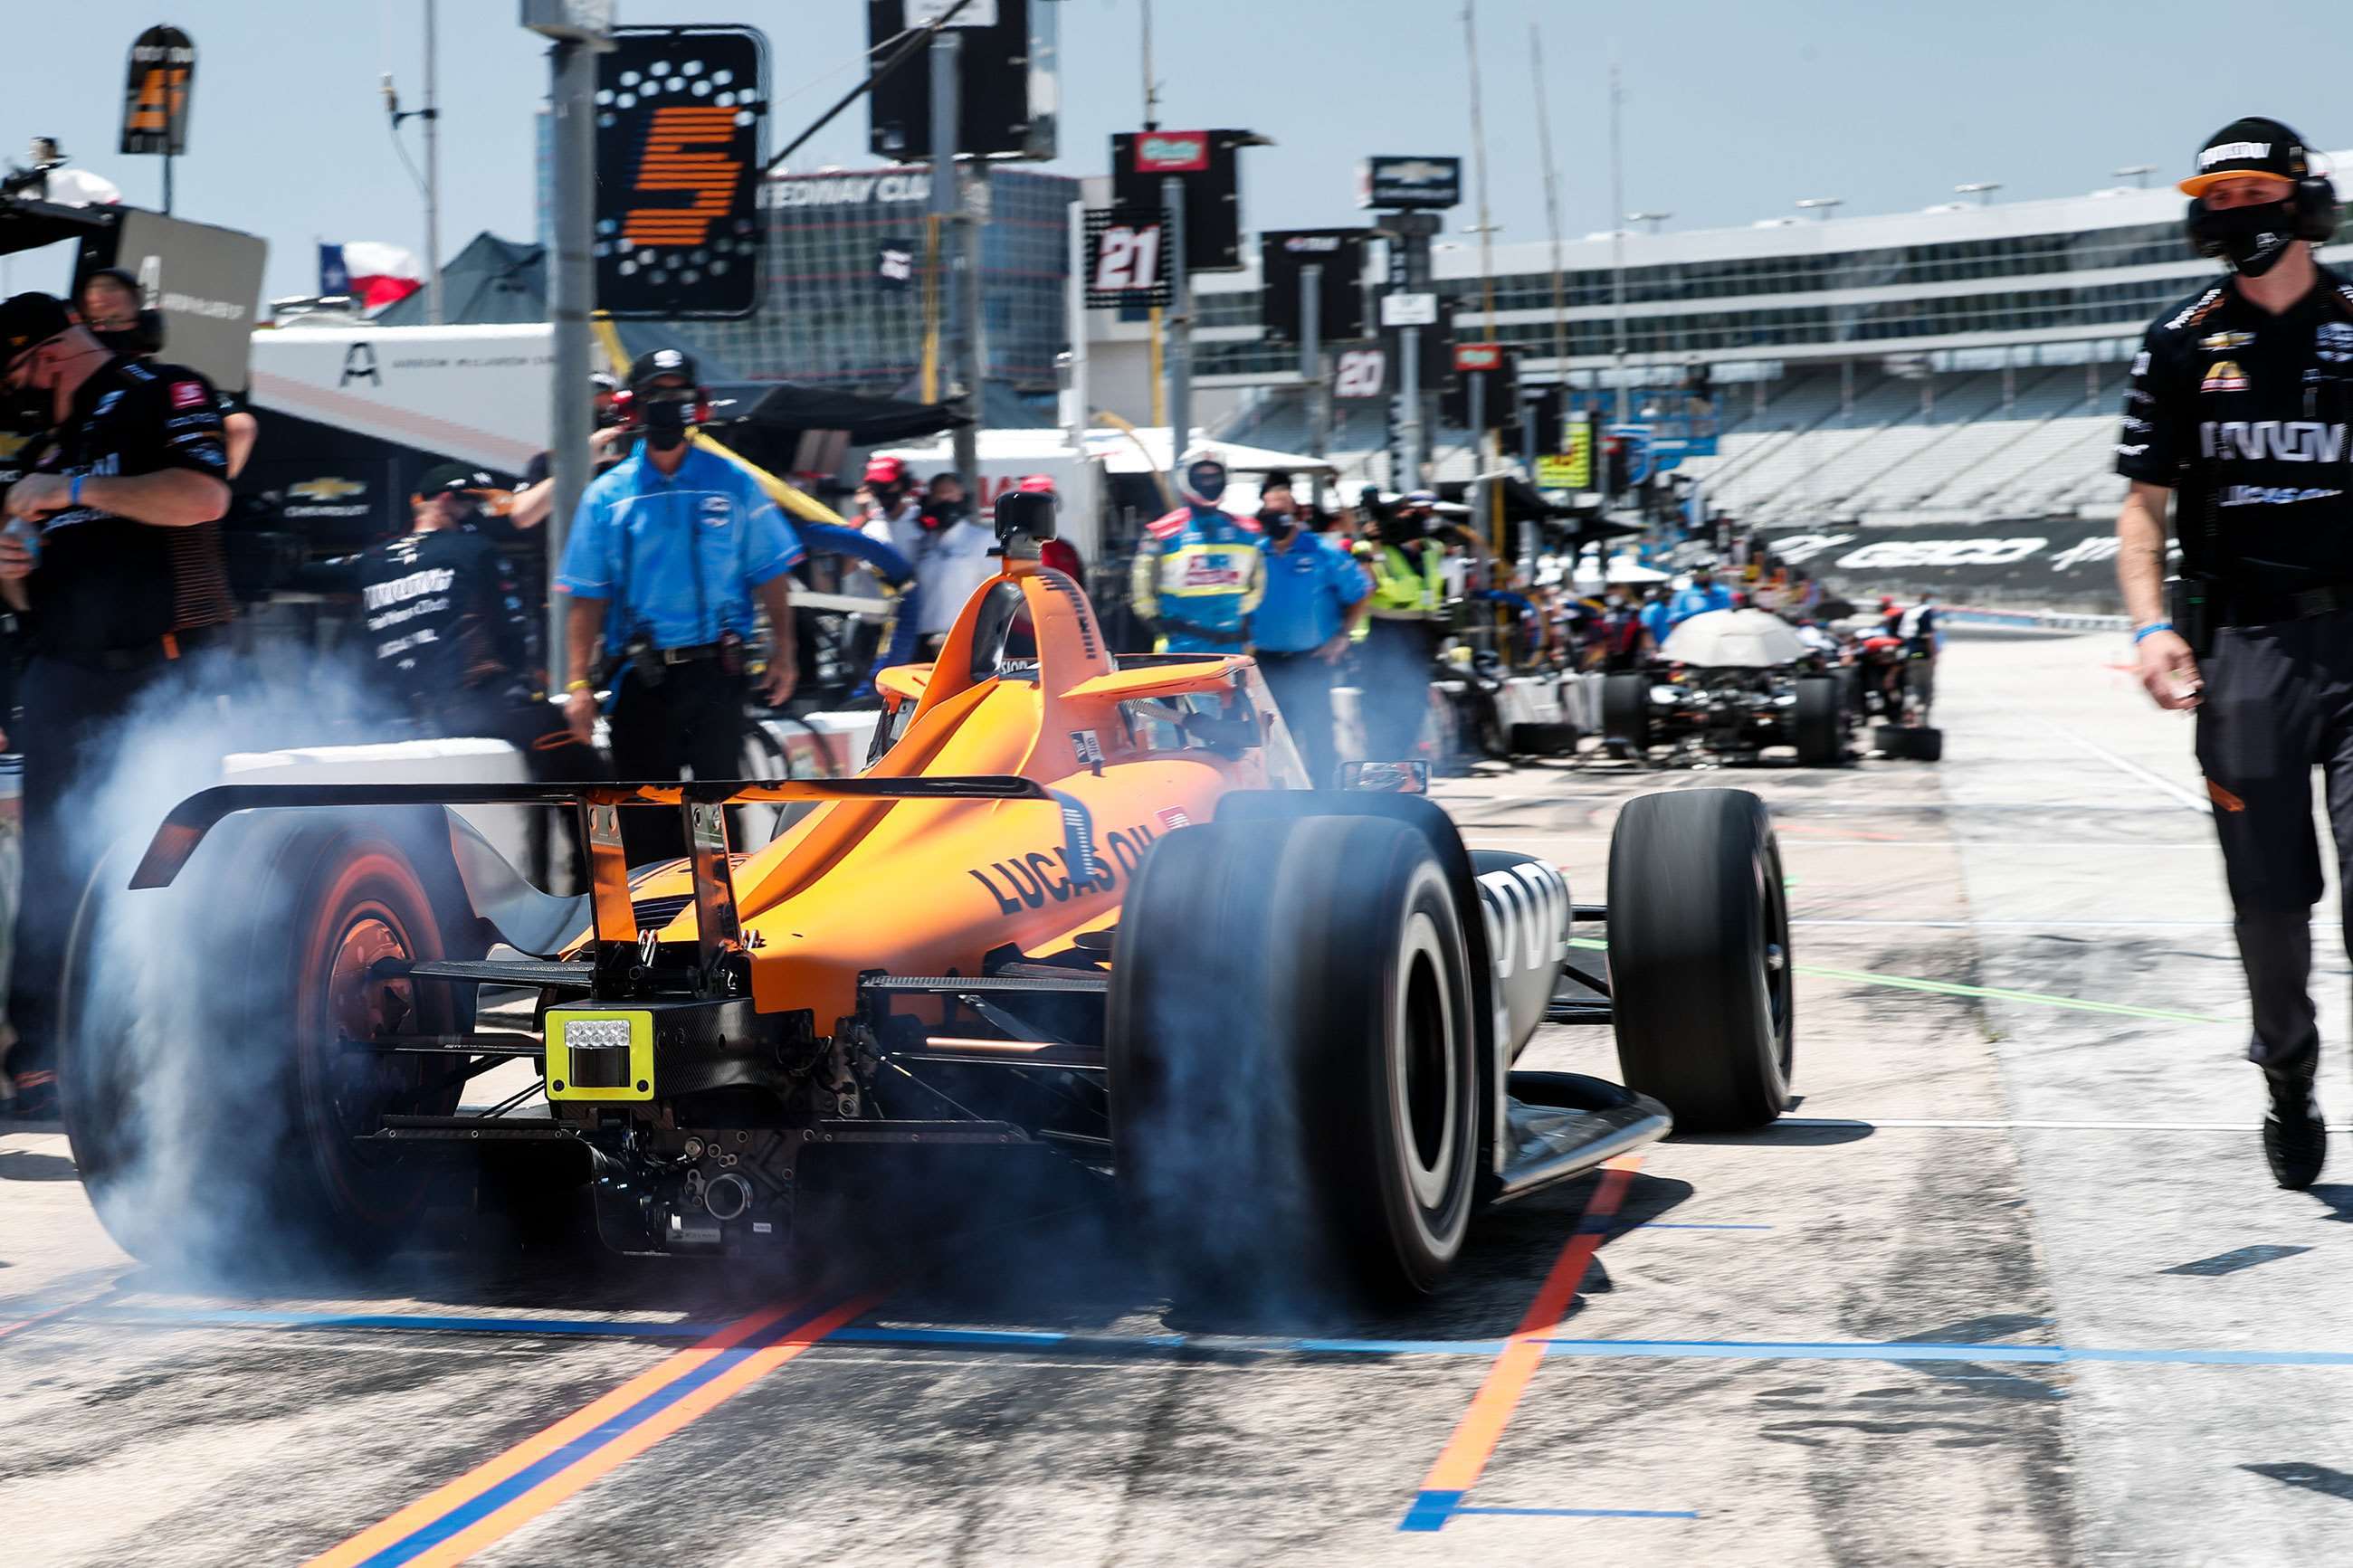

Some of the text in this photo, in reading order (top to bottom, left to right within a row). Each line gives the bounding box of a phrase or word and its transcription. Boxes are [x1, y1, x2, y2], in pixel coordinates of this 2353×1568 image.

[621, 106, 744, 245] 5
[1096, 224, 1162, 290] 21
[1333, 348, 1386, 398] 20
